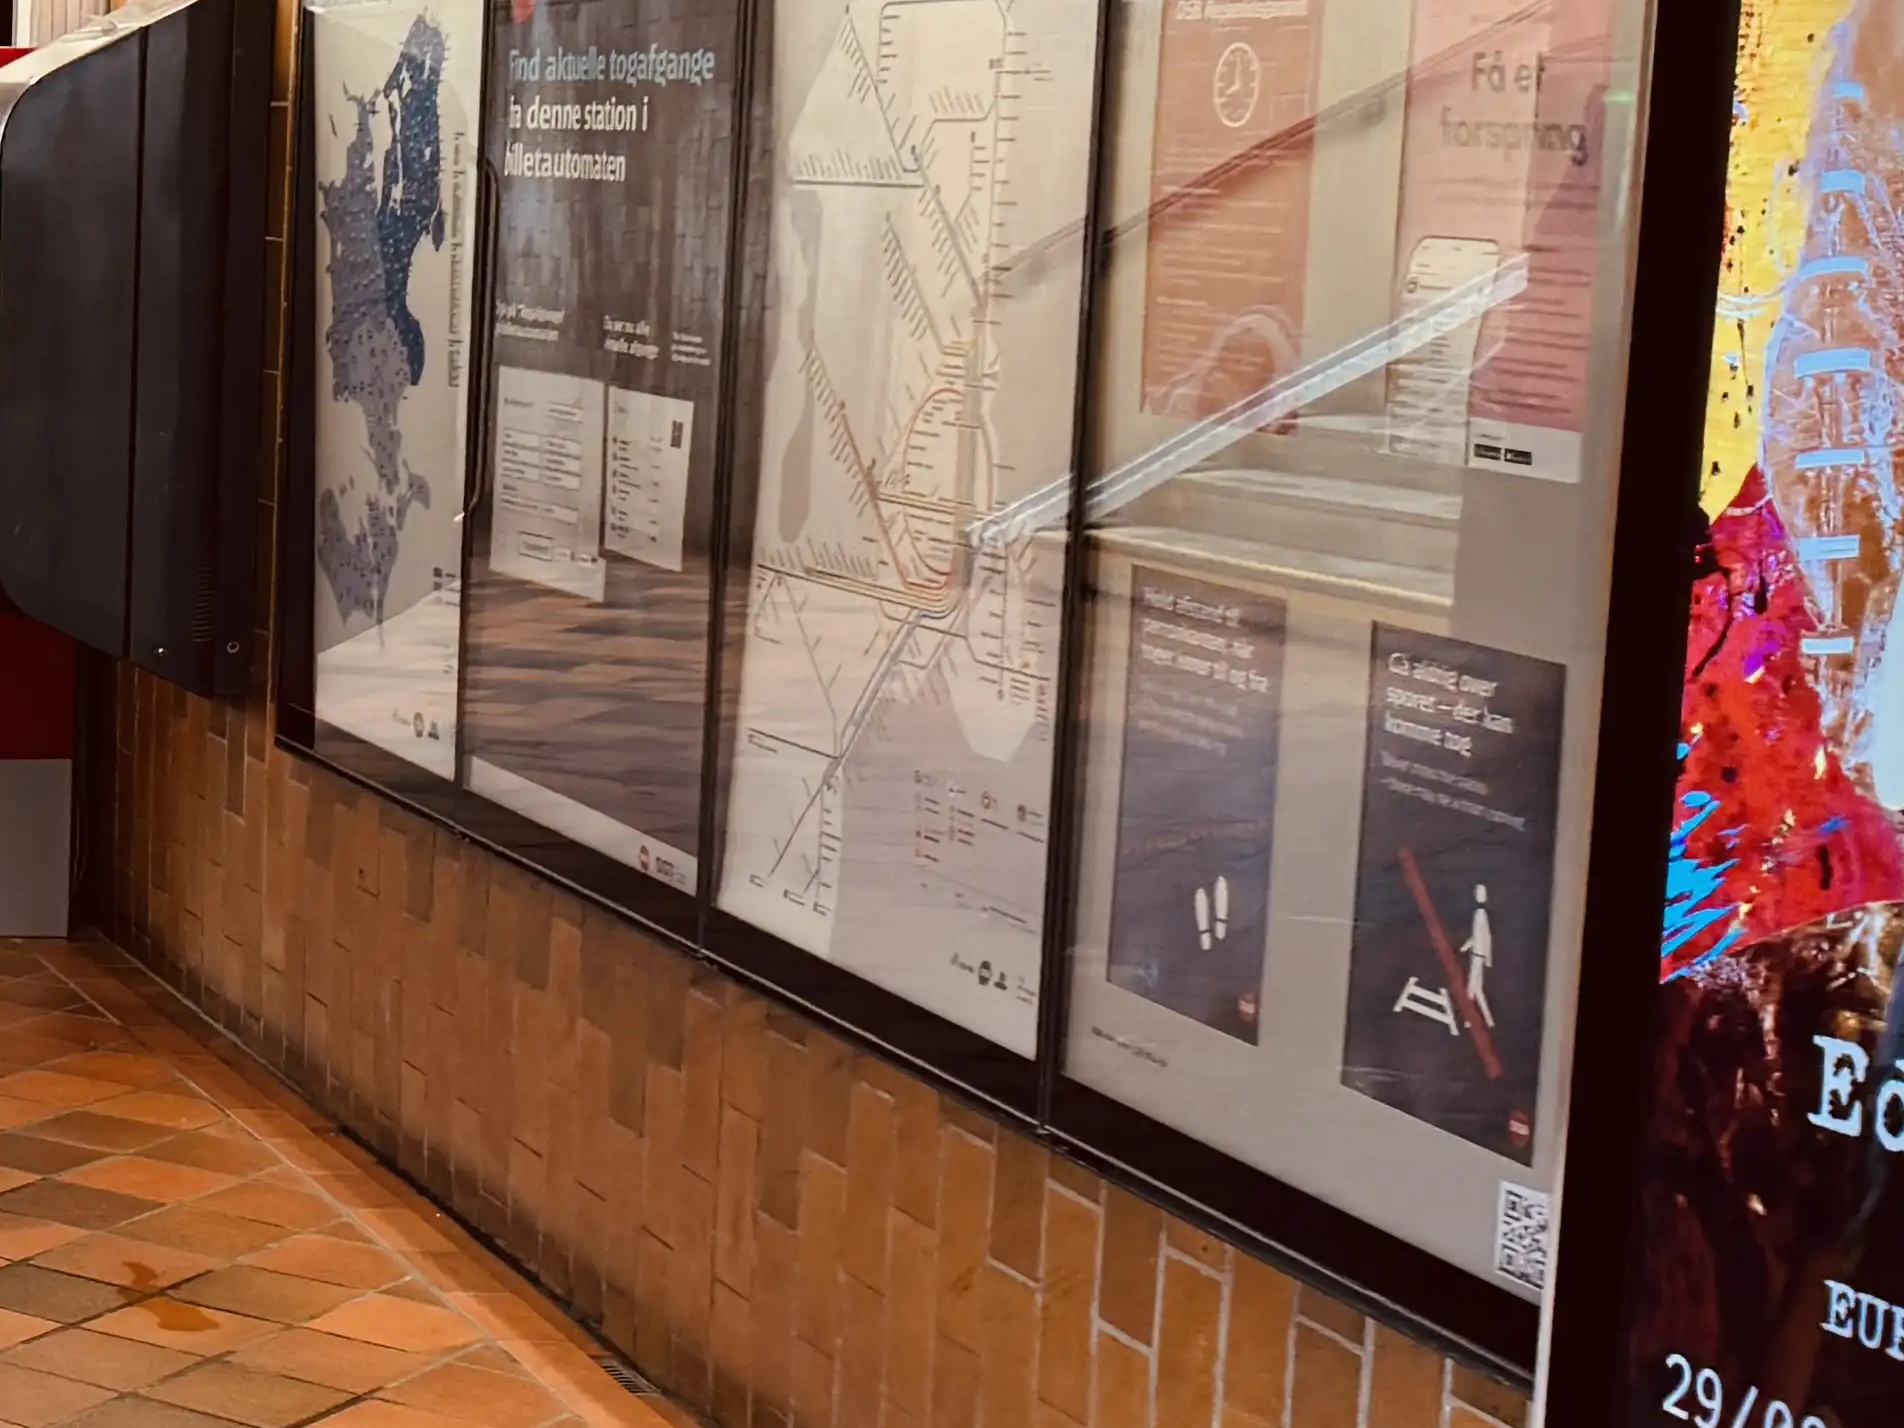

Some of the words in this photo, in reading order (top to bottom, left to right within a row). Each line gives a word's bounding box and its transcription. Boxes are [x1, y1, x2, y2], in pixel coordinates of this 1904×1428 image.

[509, 47, 541, 83] Find
[545, 45, 606, 82] aktuelle
[609, 42, 716, 88] togafgange
[526, 94, 581, 131] denne
[583, 95, 637, 132] station
[641, 96, 649, 132] i
[503, 138, 627, 183] billetautomaten
